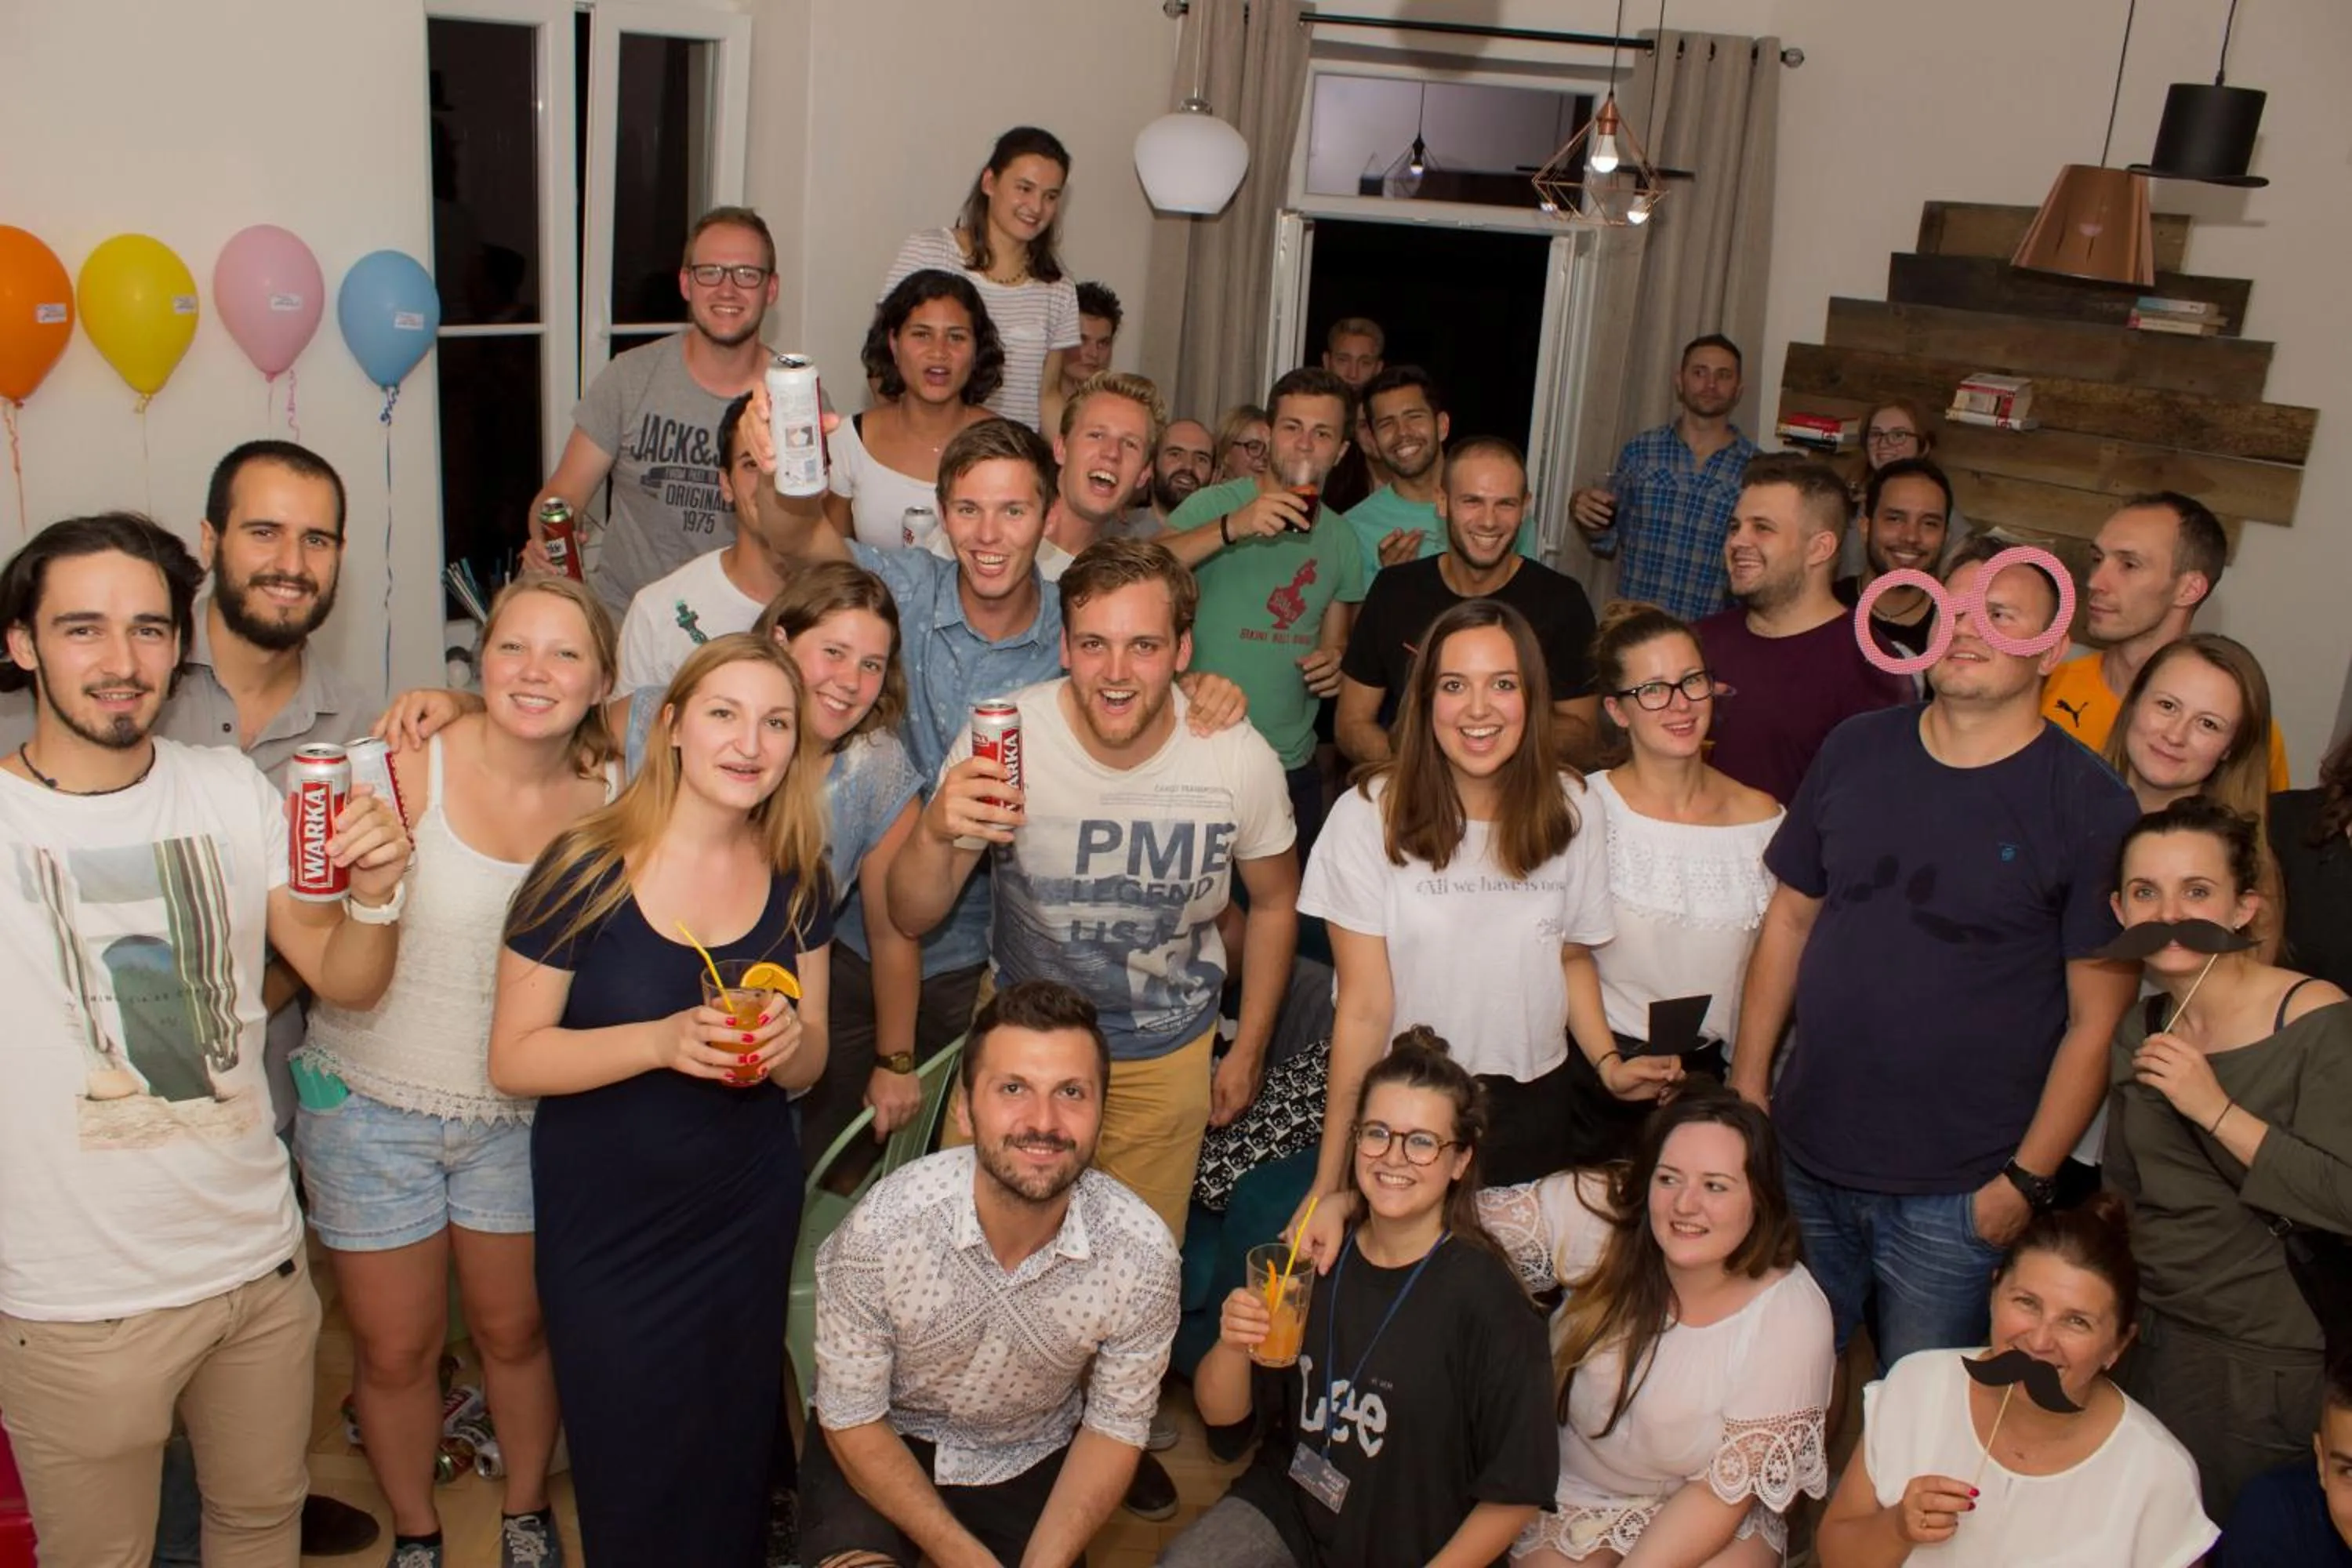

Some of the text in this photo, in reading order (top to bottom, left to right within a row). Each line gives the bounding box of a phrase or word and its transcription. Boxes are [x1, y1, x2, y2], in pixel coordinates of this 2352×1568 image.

[683, 510, 715, 535] 1975
[304, 786, 326, 881] WARKA
[1075, 819, 1236, 880] PME
[1071, 877, 1214, 907] LEGEND
[1453, 880, 1475, 893] we
